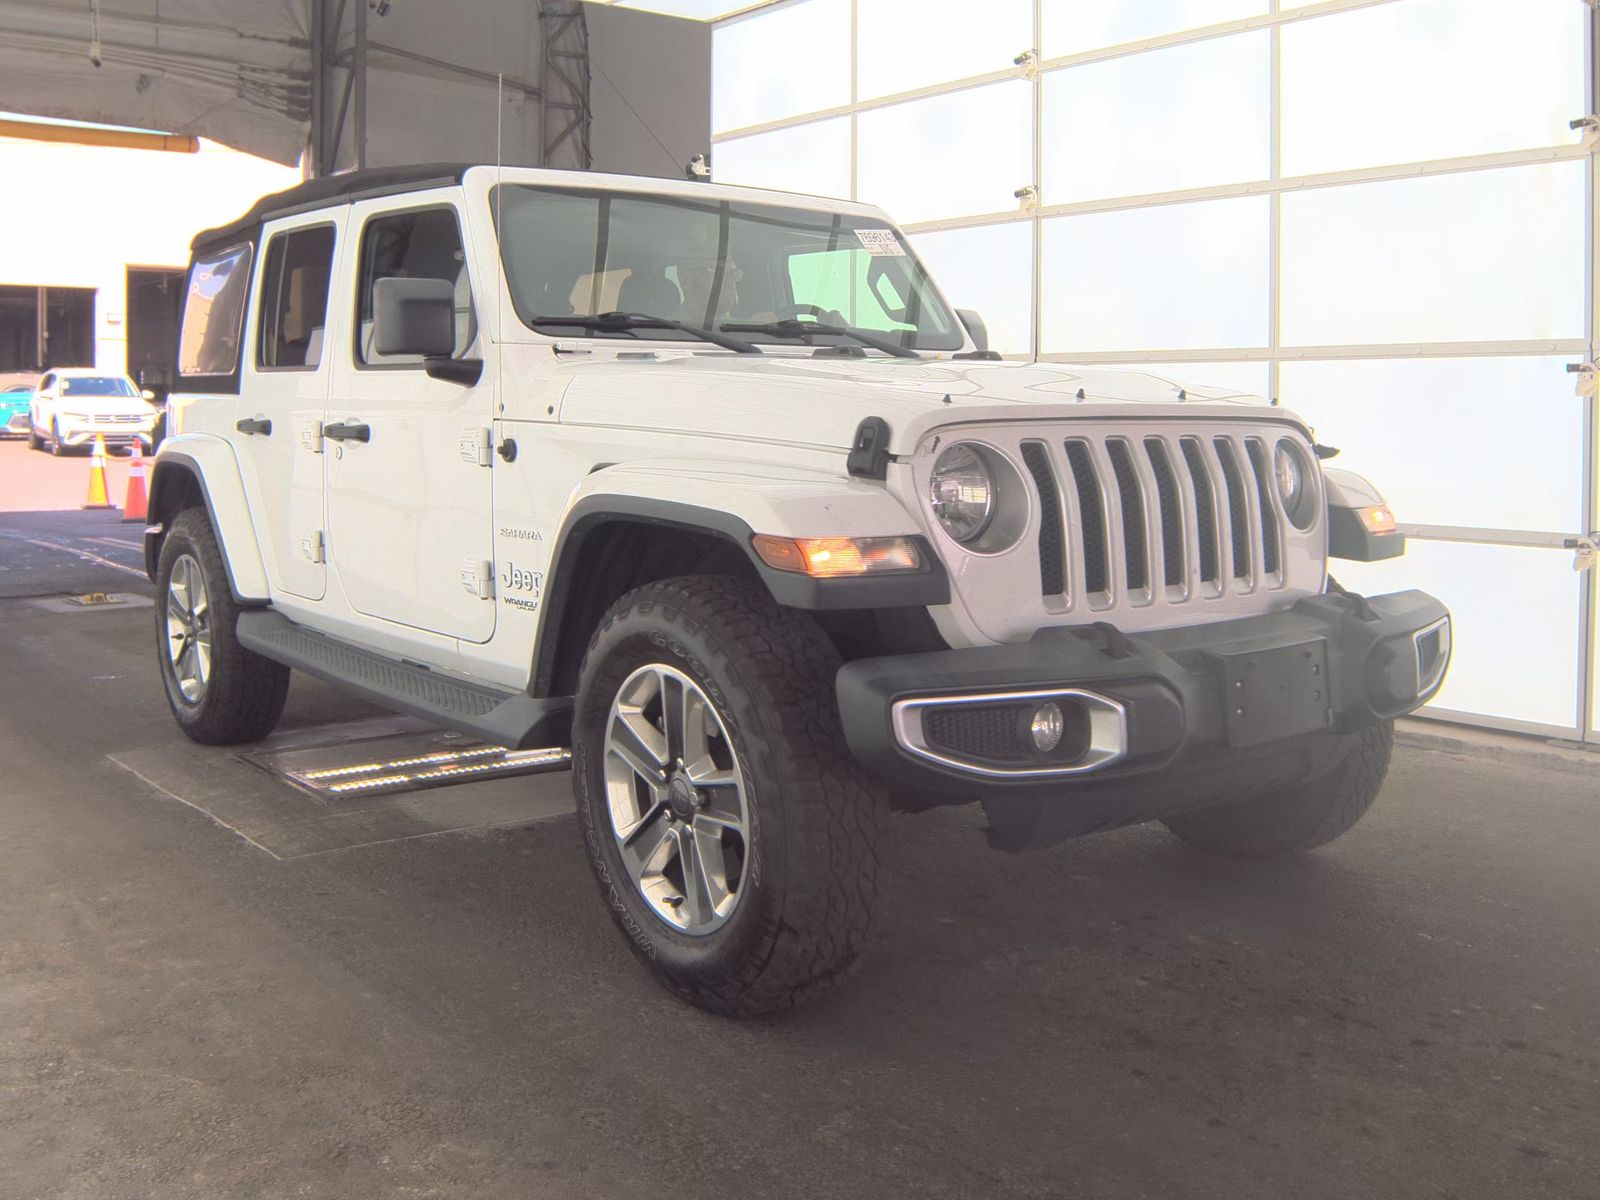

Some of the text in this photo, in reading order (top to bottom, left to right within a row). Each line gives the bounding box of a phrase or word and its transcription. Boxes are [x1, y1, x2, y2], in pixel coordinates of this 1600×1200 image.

[500, 528, 542, 541] SAHARA
[502, 561, 543, 598] Jeep
[503, 596, 538, 609] WRANGL
